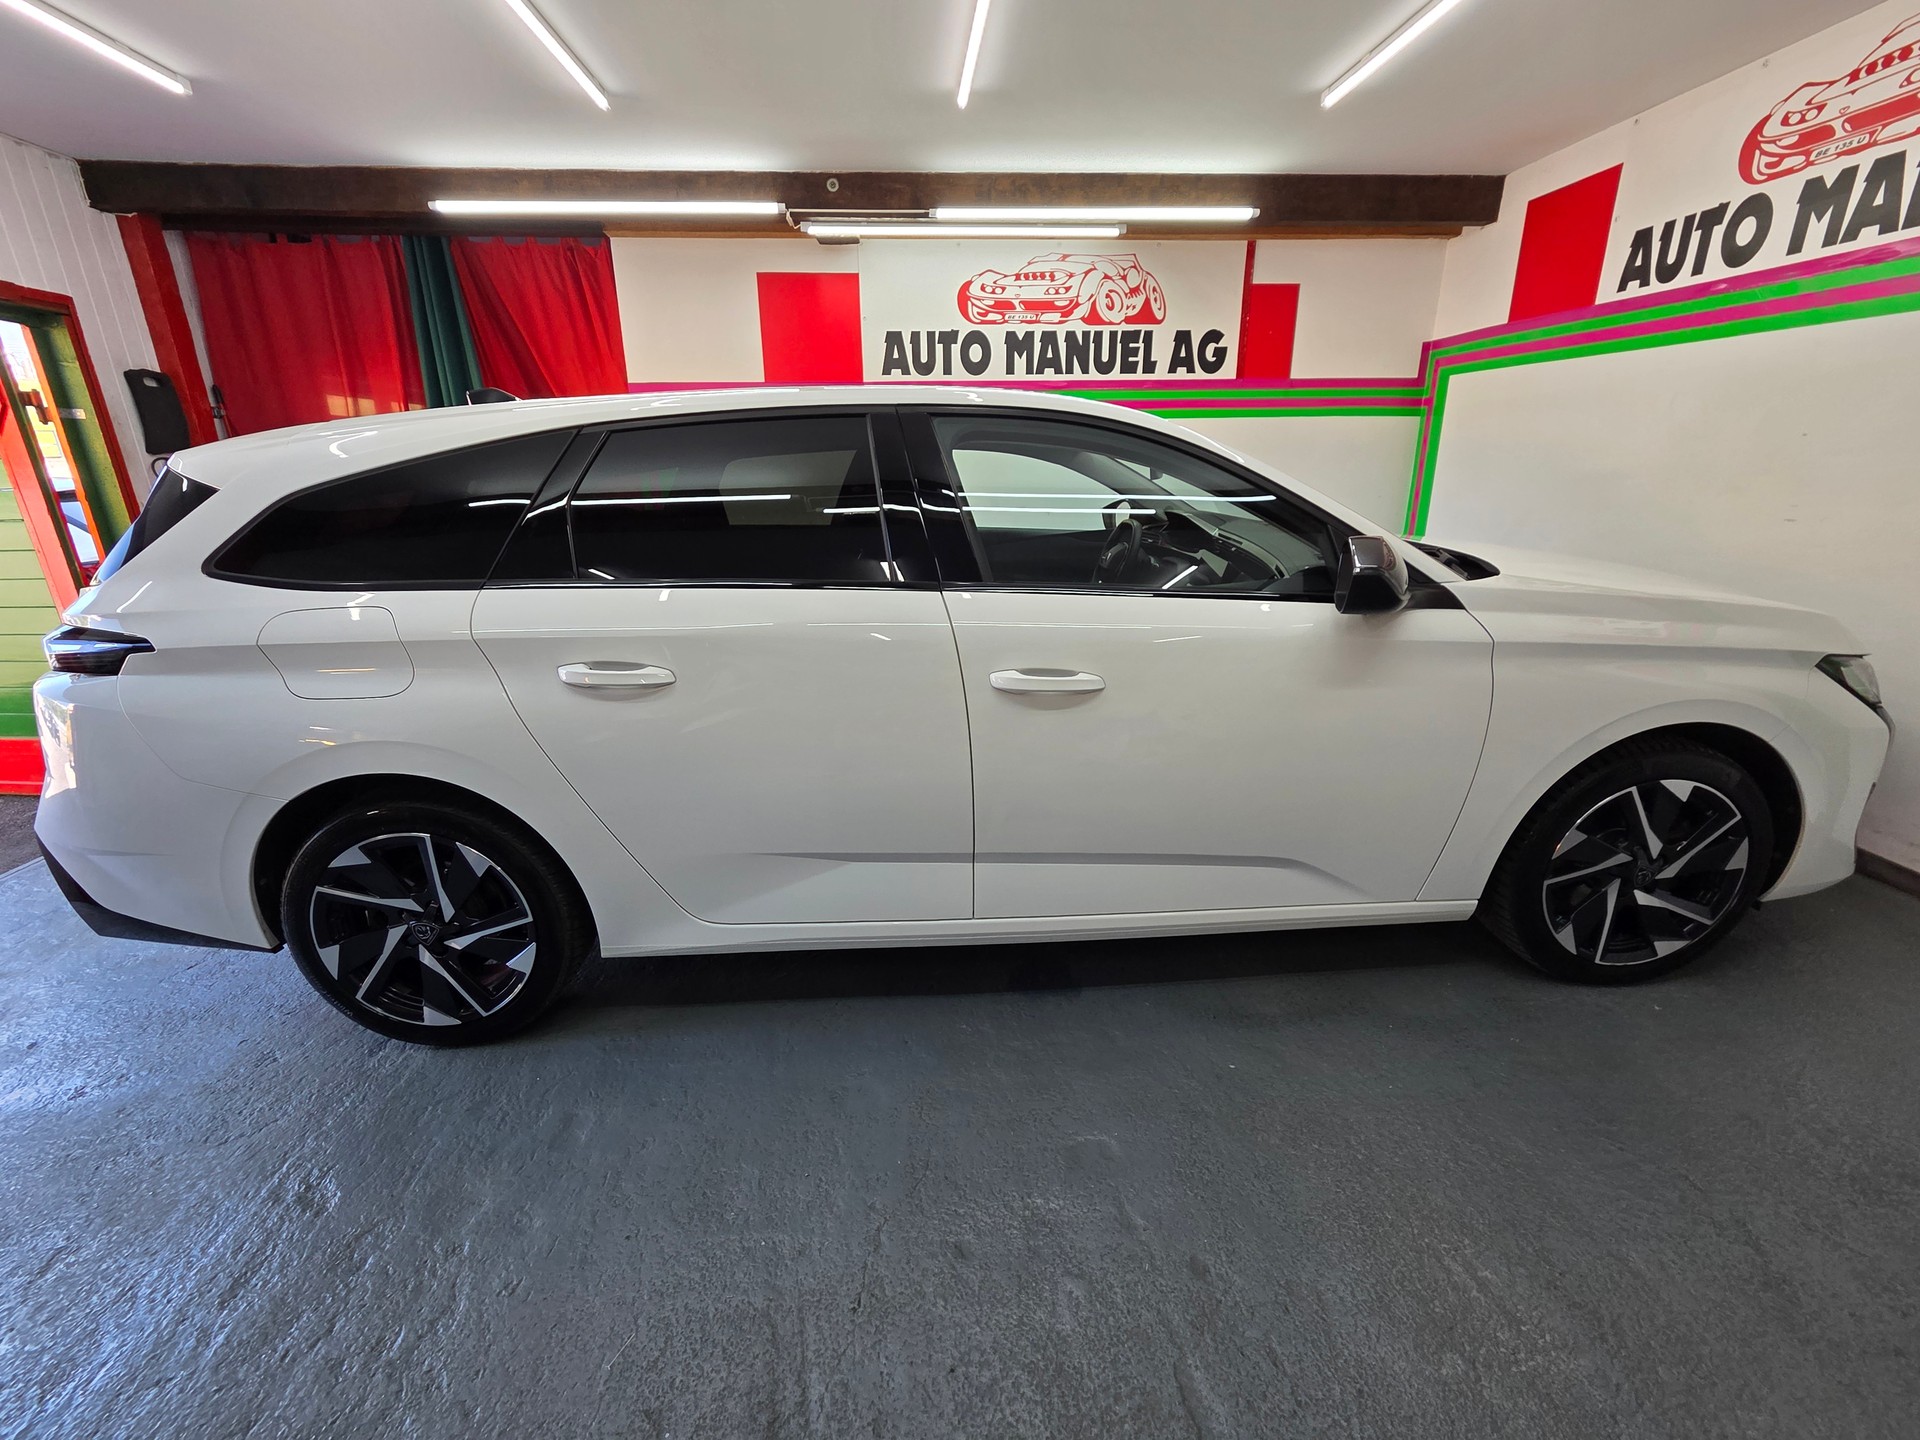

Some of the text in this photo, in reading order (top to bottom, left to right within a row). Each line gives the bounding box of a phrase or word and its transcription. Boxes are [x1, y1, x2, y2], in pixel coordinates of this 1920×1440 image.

[1815, 135, 1867, 159] BE 135 U
[1617, 192, 1773, 293] AUTO
[882, 328, 1228, 376] AUTO MANUEL AG
